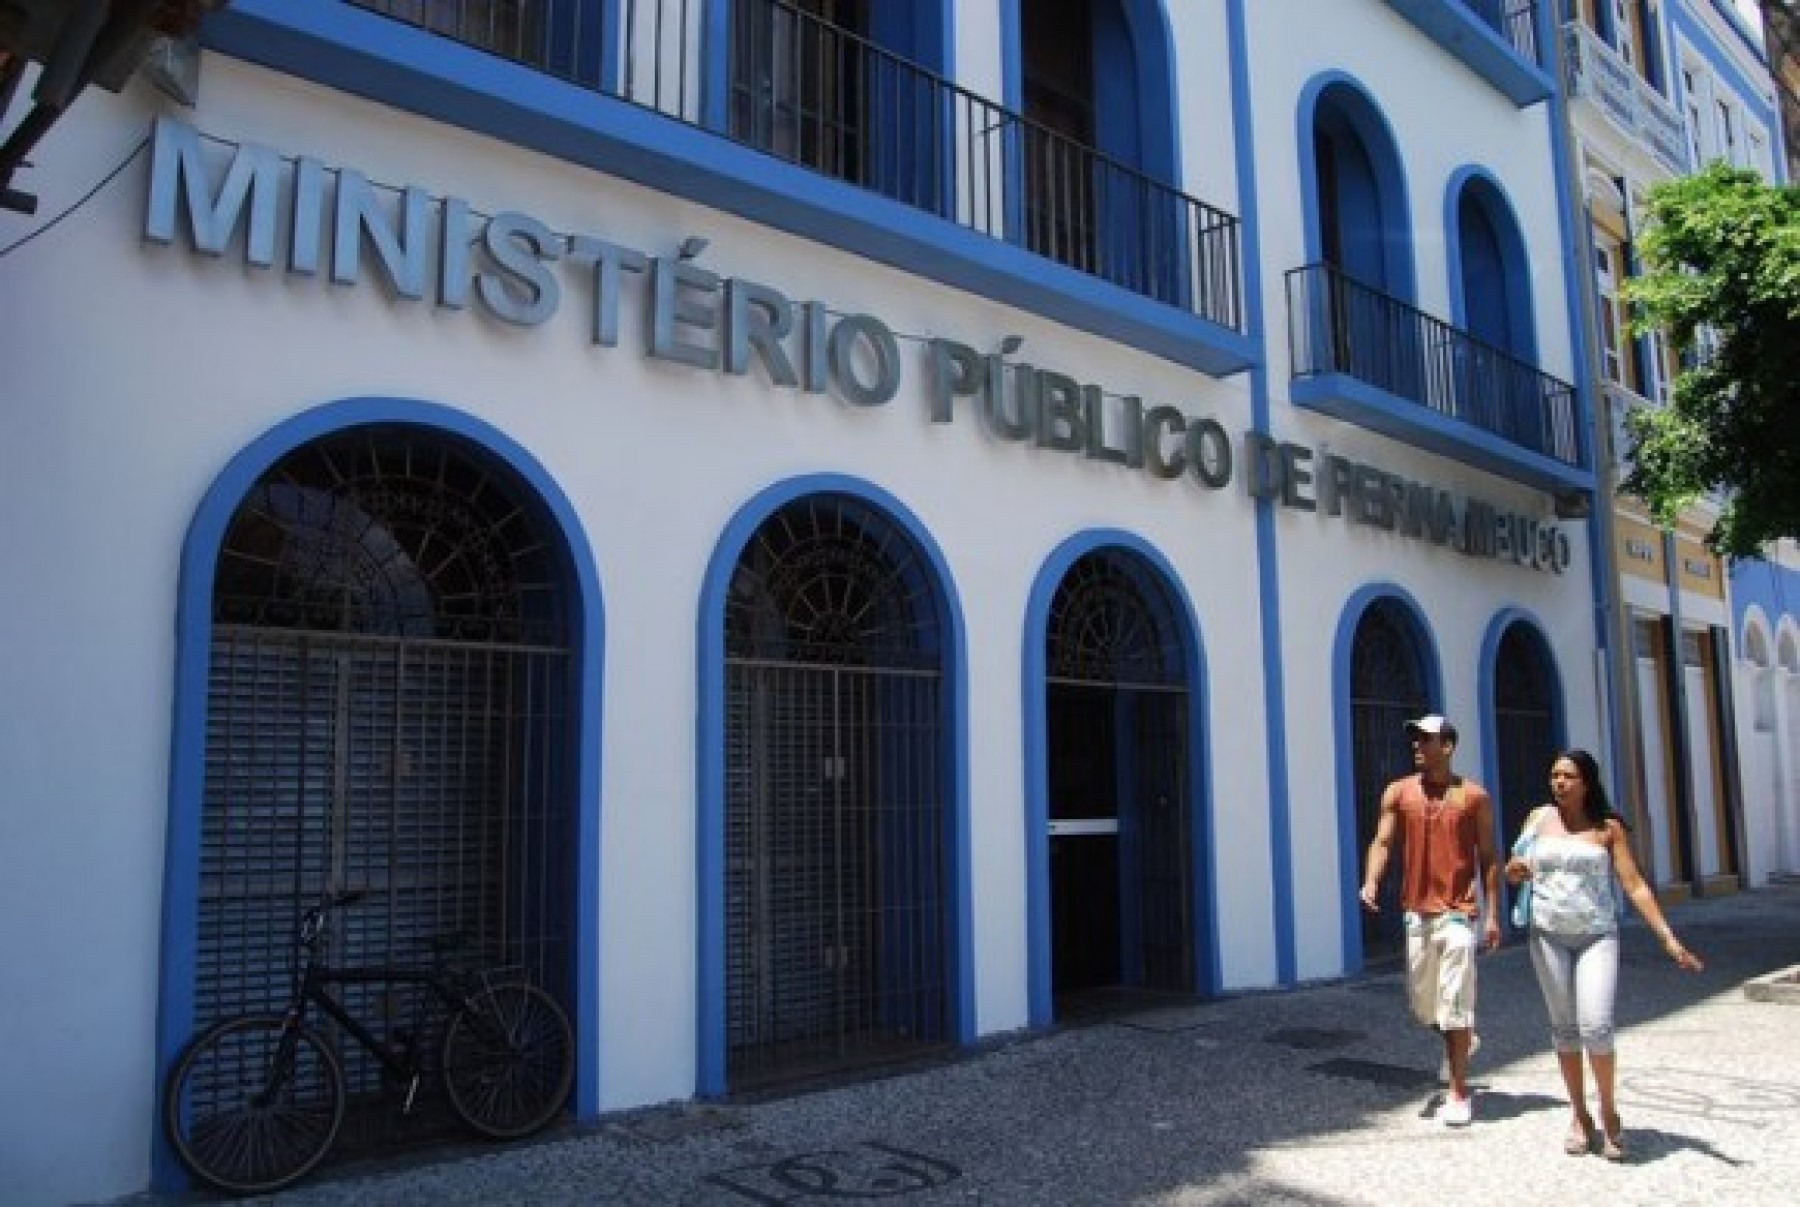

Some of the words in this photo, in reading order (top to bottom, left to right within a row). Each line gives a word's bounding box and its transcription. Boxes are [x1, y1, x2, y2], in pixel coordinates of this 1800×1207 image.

[142, 115, 901, 407] MINISTÉRIO
[926, 334, 1233, 488] PÚBLICO
[1245, 430, 1317, 513] DE
